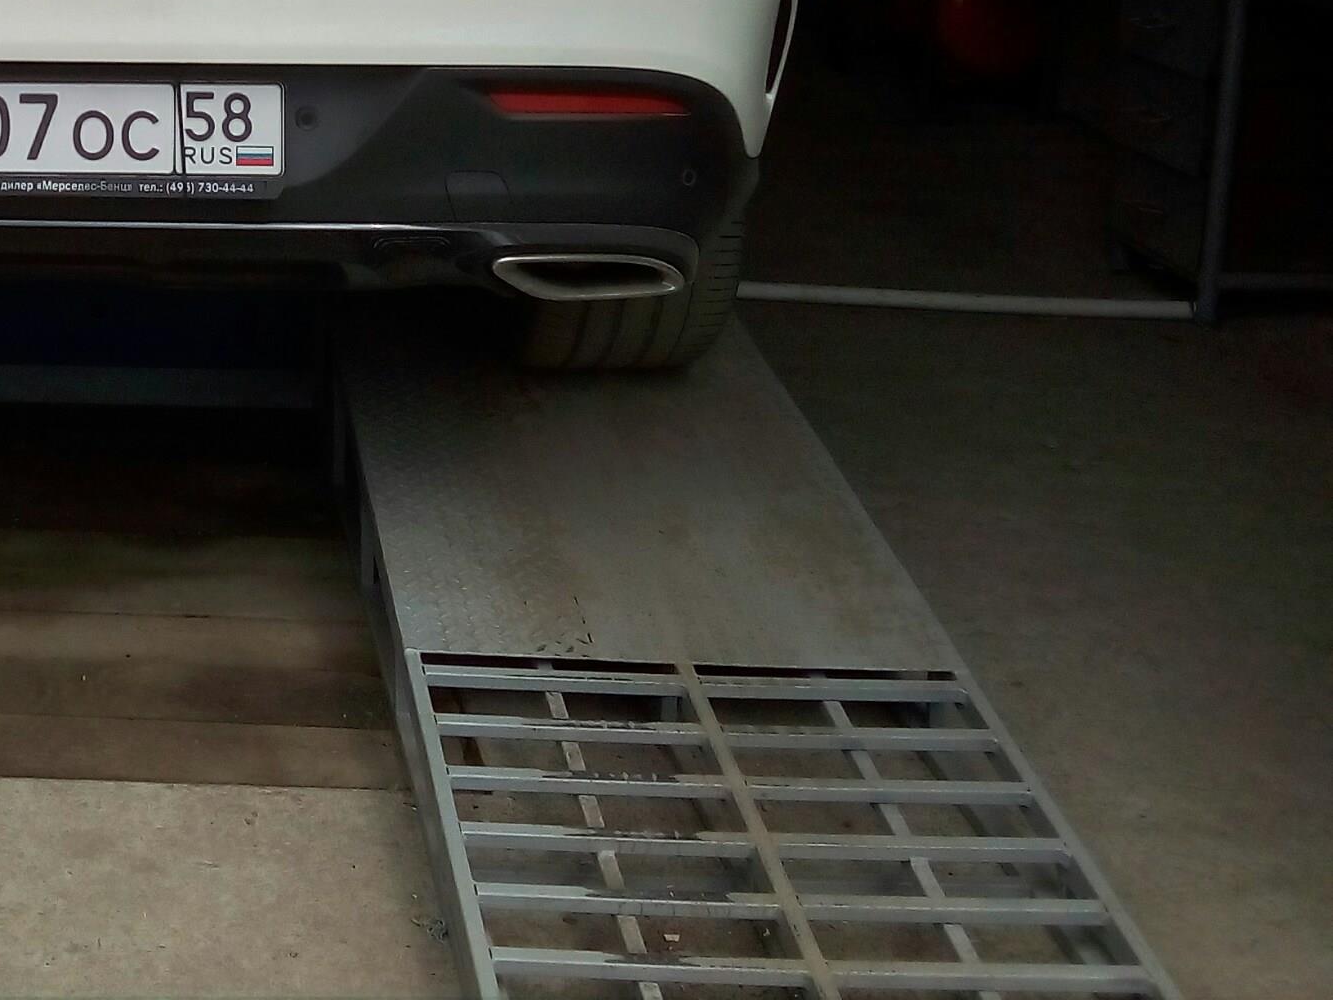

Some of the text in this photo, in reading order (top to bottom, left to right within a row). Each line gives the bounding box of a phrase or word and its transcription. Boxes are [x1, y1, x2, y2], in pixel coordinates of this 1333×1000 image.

[185, 91, 252, 142] 58
[184, 146, 233, 165] RUS
[1, 181, 34, 192] дилер
[198, 182, 254, 193] 730-44-44
